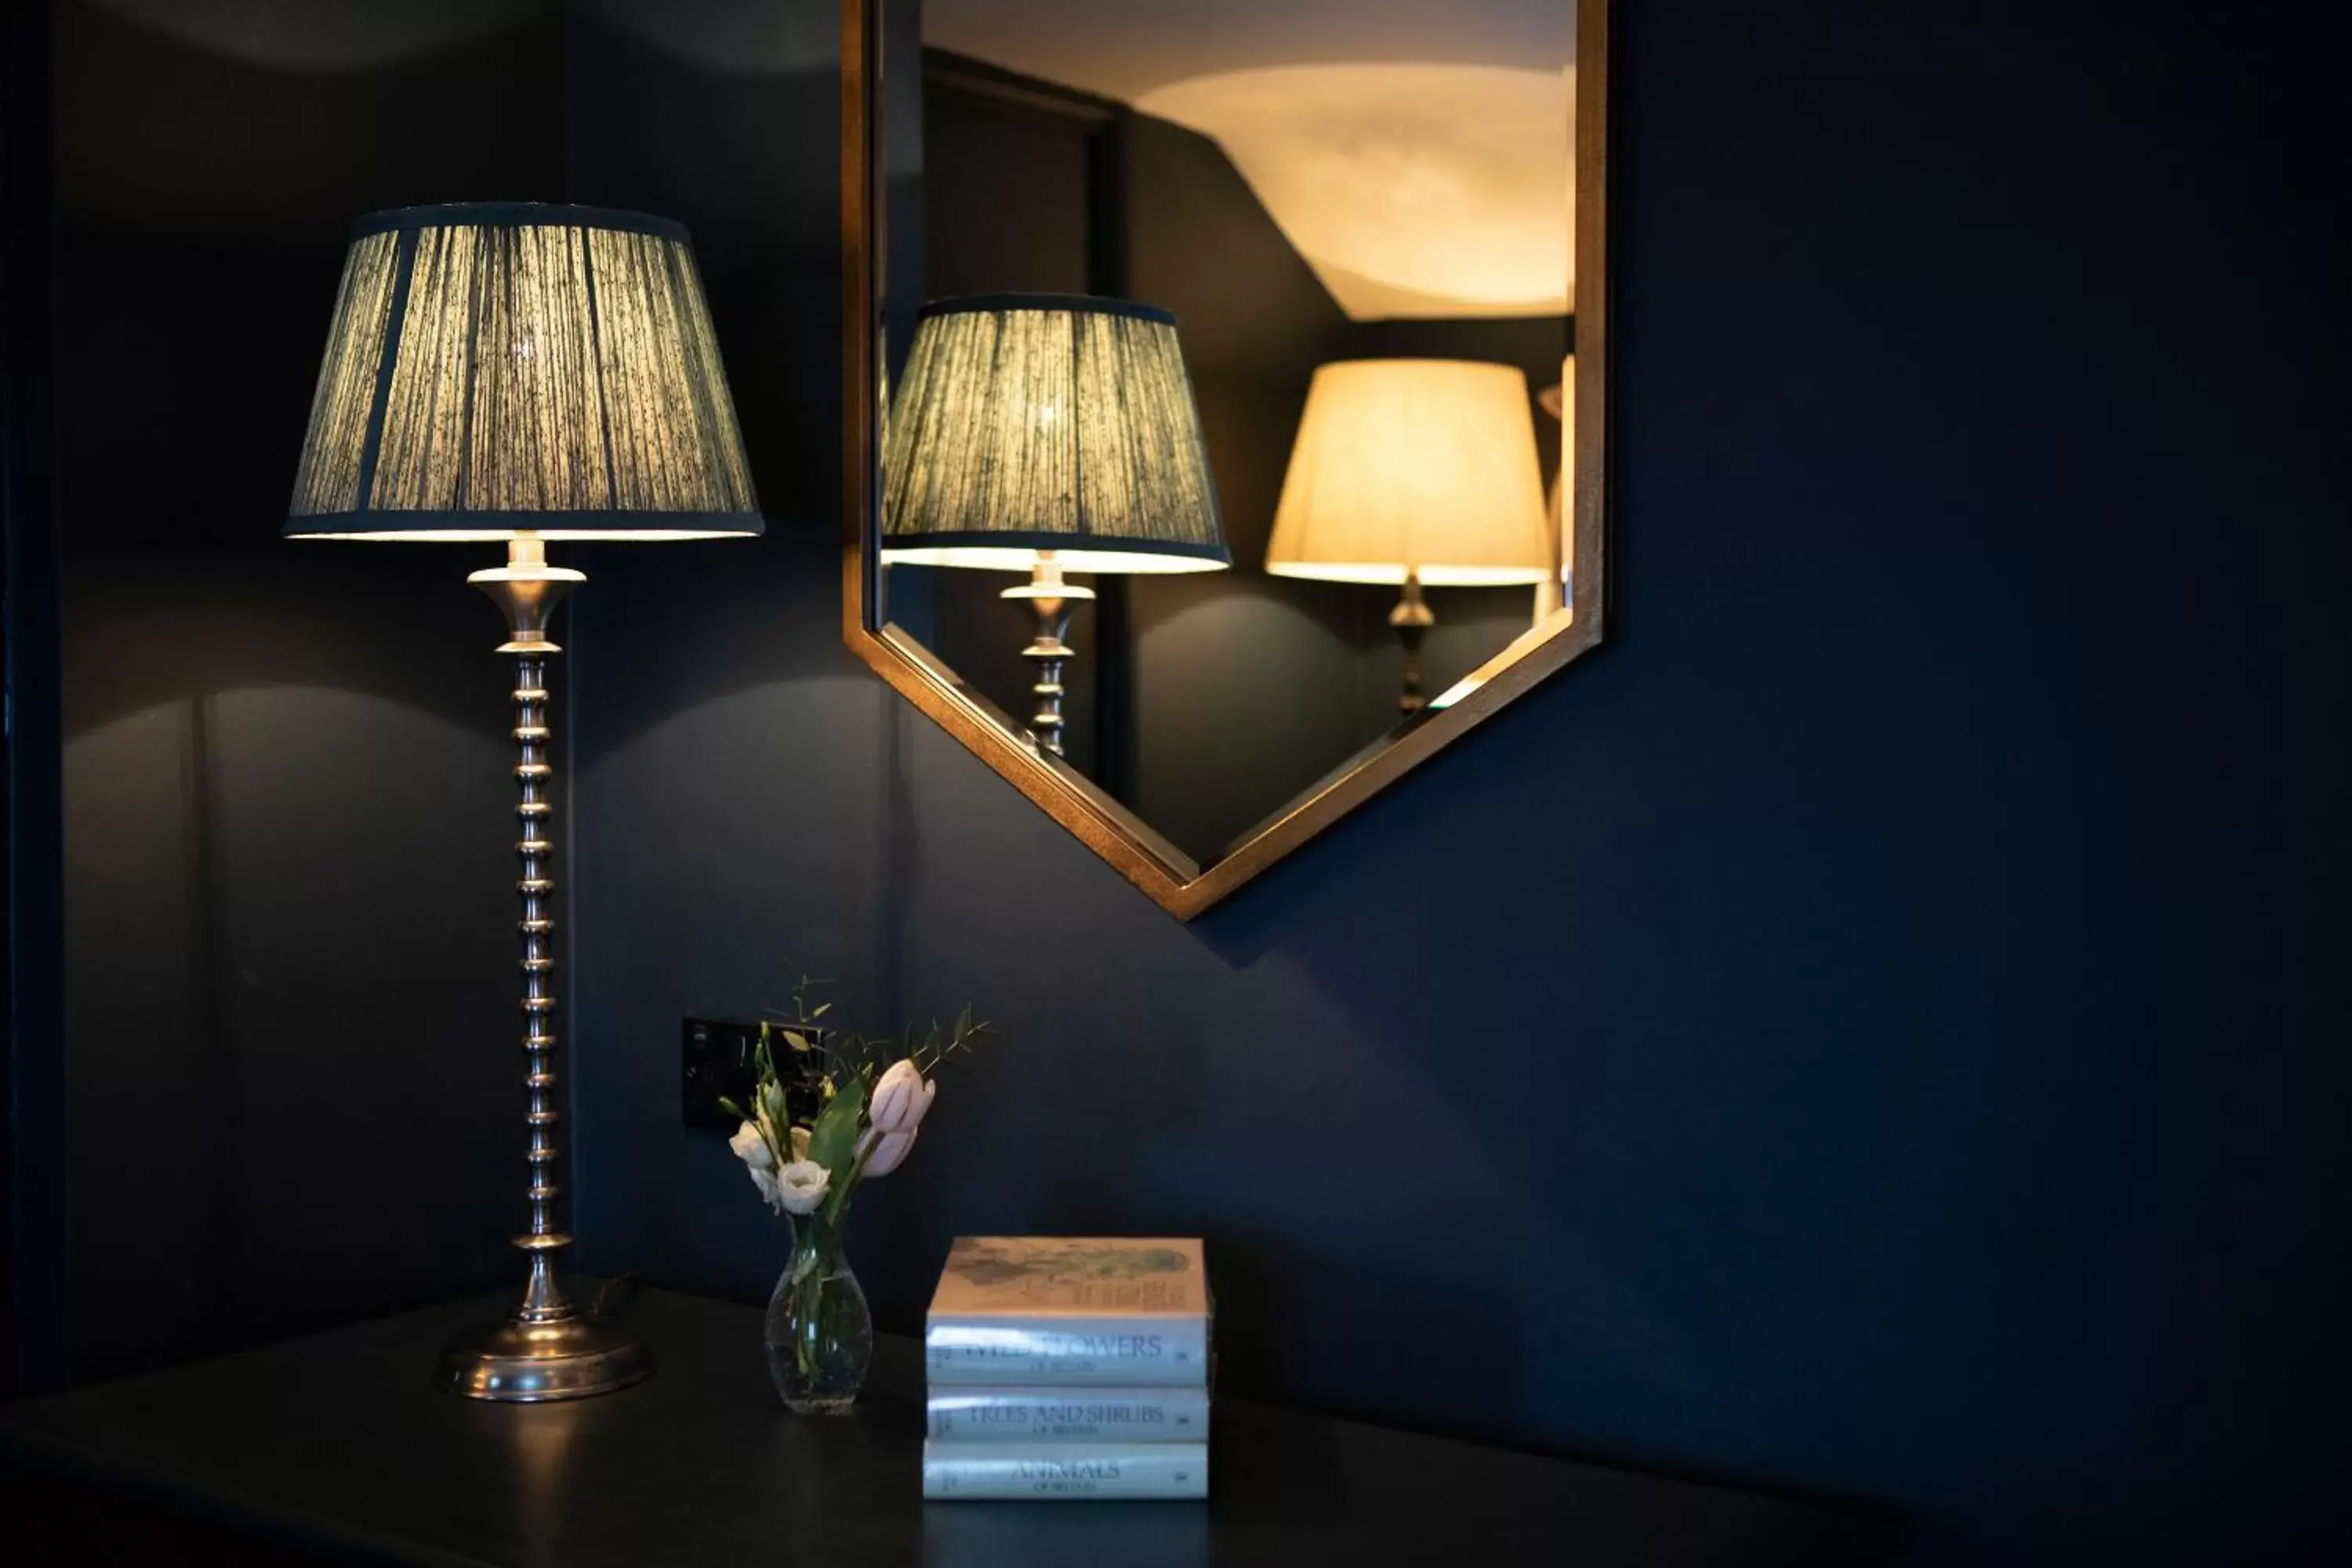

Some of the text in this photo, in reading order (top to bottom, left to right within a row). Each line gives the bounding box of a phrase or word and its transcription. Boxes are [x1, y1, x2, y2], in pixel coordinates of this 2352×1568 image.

[969, 1405, 1028, 1424] TREES
[1033, 1405, 1083, 1424] AND
[1087, 1405, 1165, 1424] SHRUBS
[1011, 1459, 1120, 1479] ANIMALS
